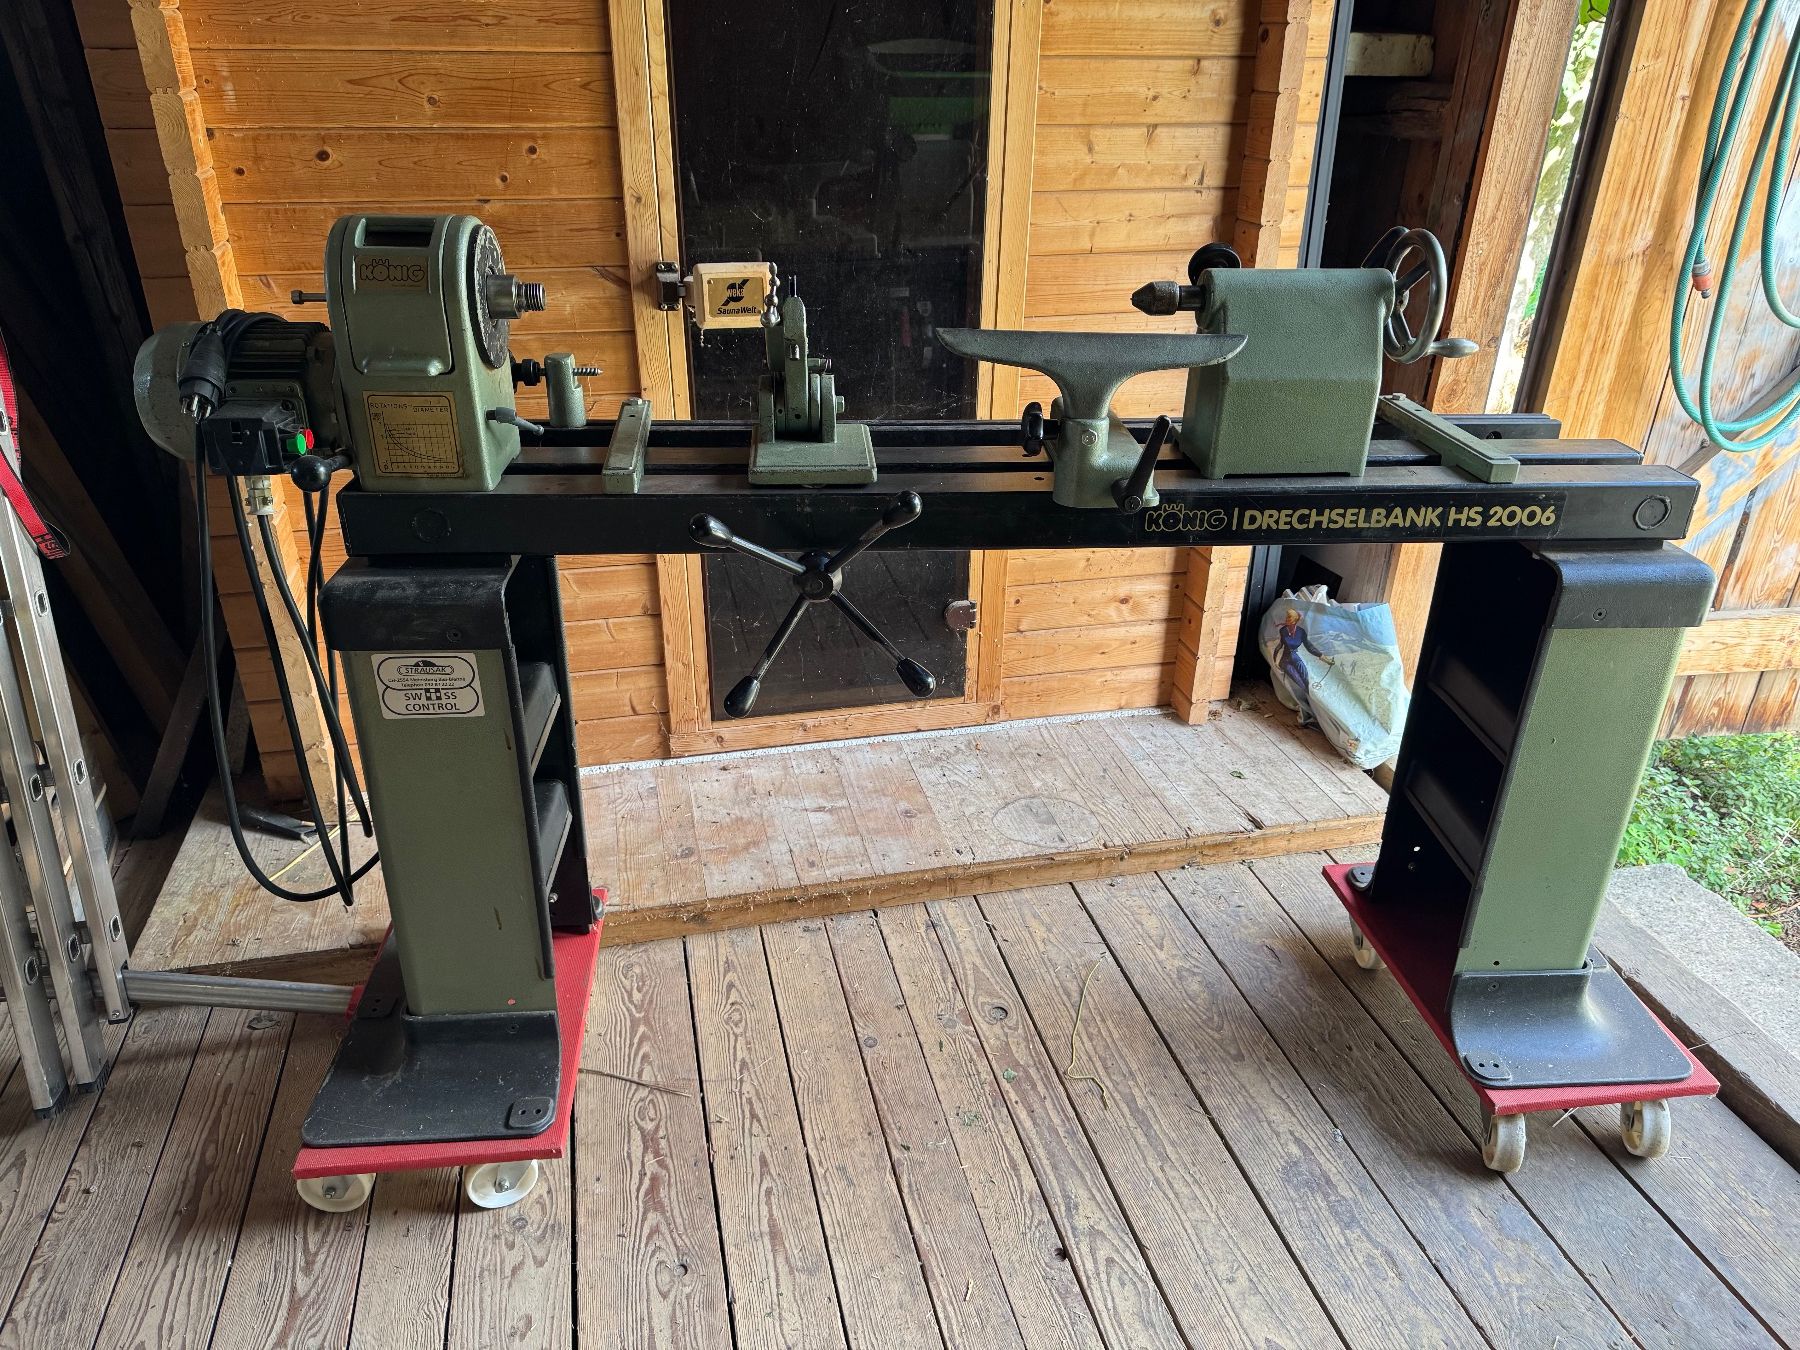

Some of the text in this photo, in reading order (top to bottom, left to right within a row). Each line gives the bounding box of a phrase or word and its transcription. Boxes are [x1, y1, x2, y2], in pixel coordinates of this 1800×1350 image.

[1145, 504, 1556, 531] KÖNIG DRECHSELBANK HS 2006
[405, 703, 460, 711] CONTROL
